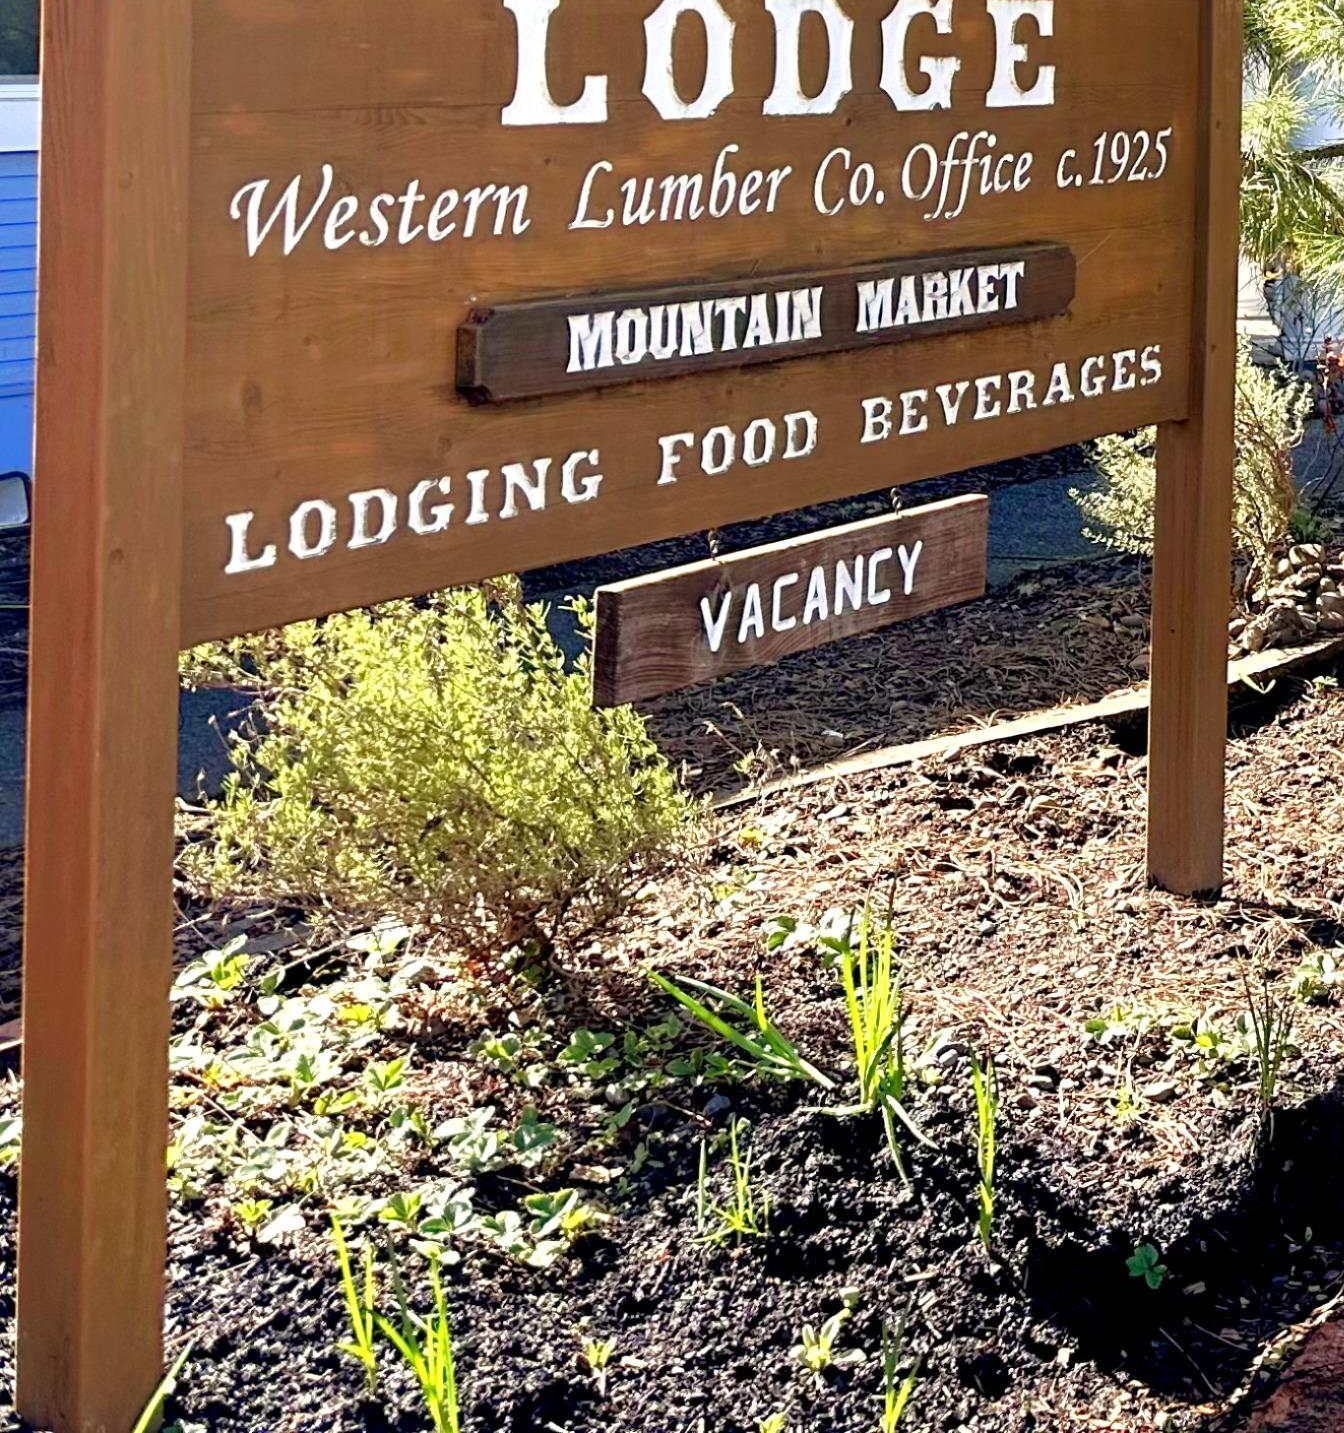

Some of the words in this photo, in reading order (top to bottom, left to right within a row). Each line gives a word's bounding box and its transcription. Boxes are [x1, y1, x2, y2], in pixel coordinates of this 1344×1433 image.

[229, 163, 531, 258] Western
[567, 143, 793, 231] Lumber
[813, 146, 886, 217] Co.
[901, 130, 1034, 221] Office
[566, 286, 824, 374] MOUNTAIN
[855, 261, 1025, 334] MARKET
[223, 448, 604, 575] LODGING
[656, 410, 819, 486] FOOD
[860, 344, 1163, 445] BEVERAGES
[699, 540, 923, 652] VACANCY
